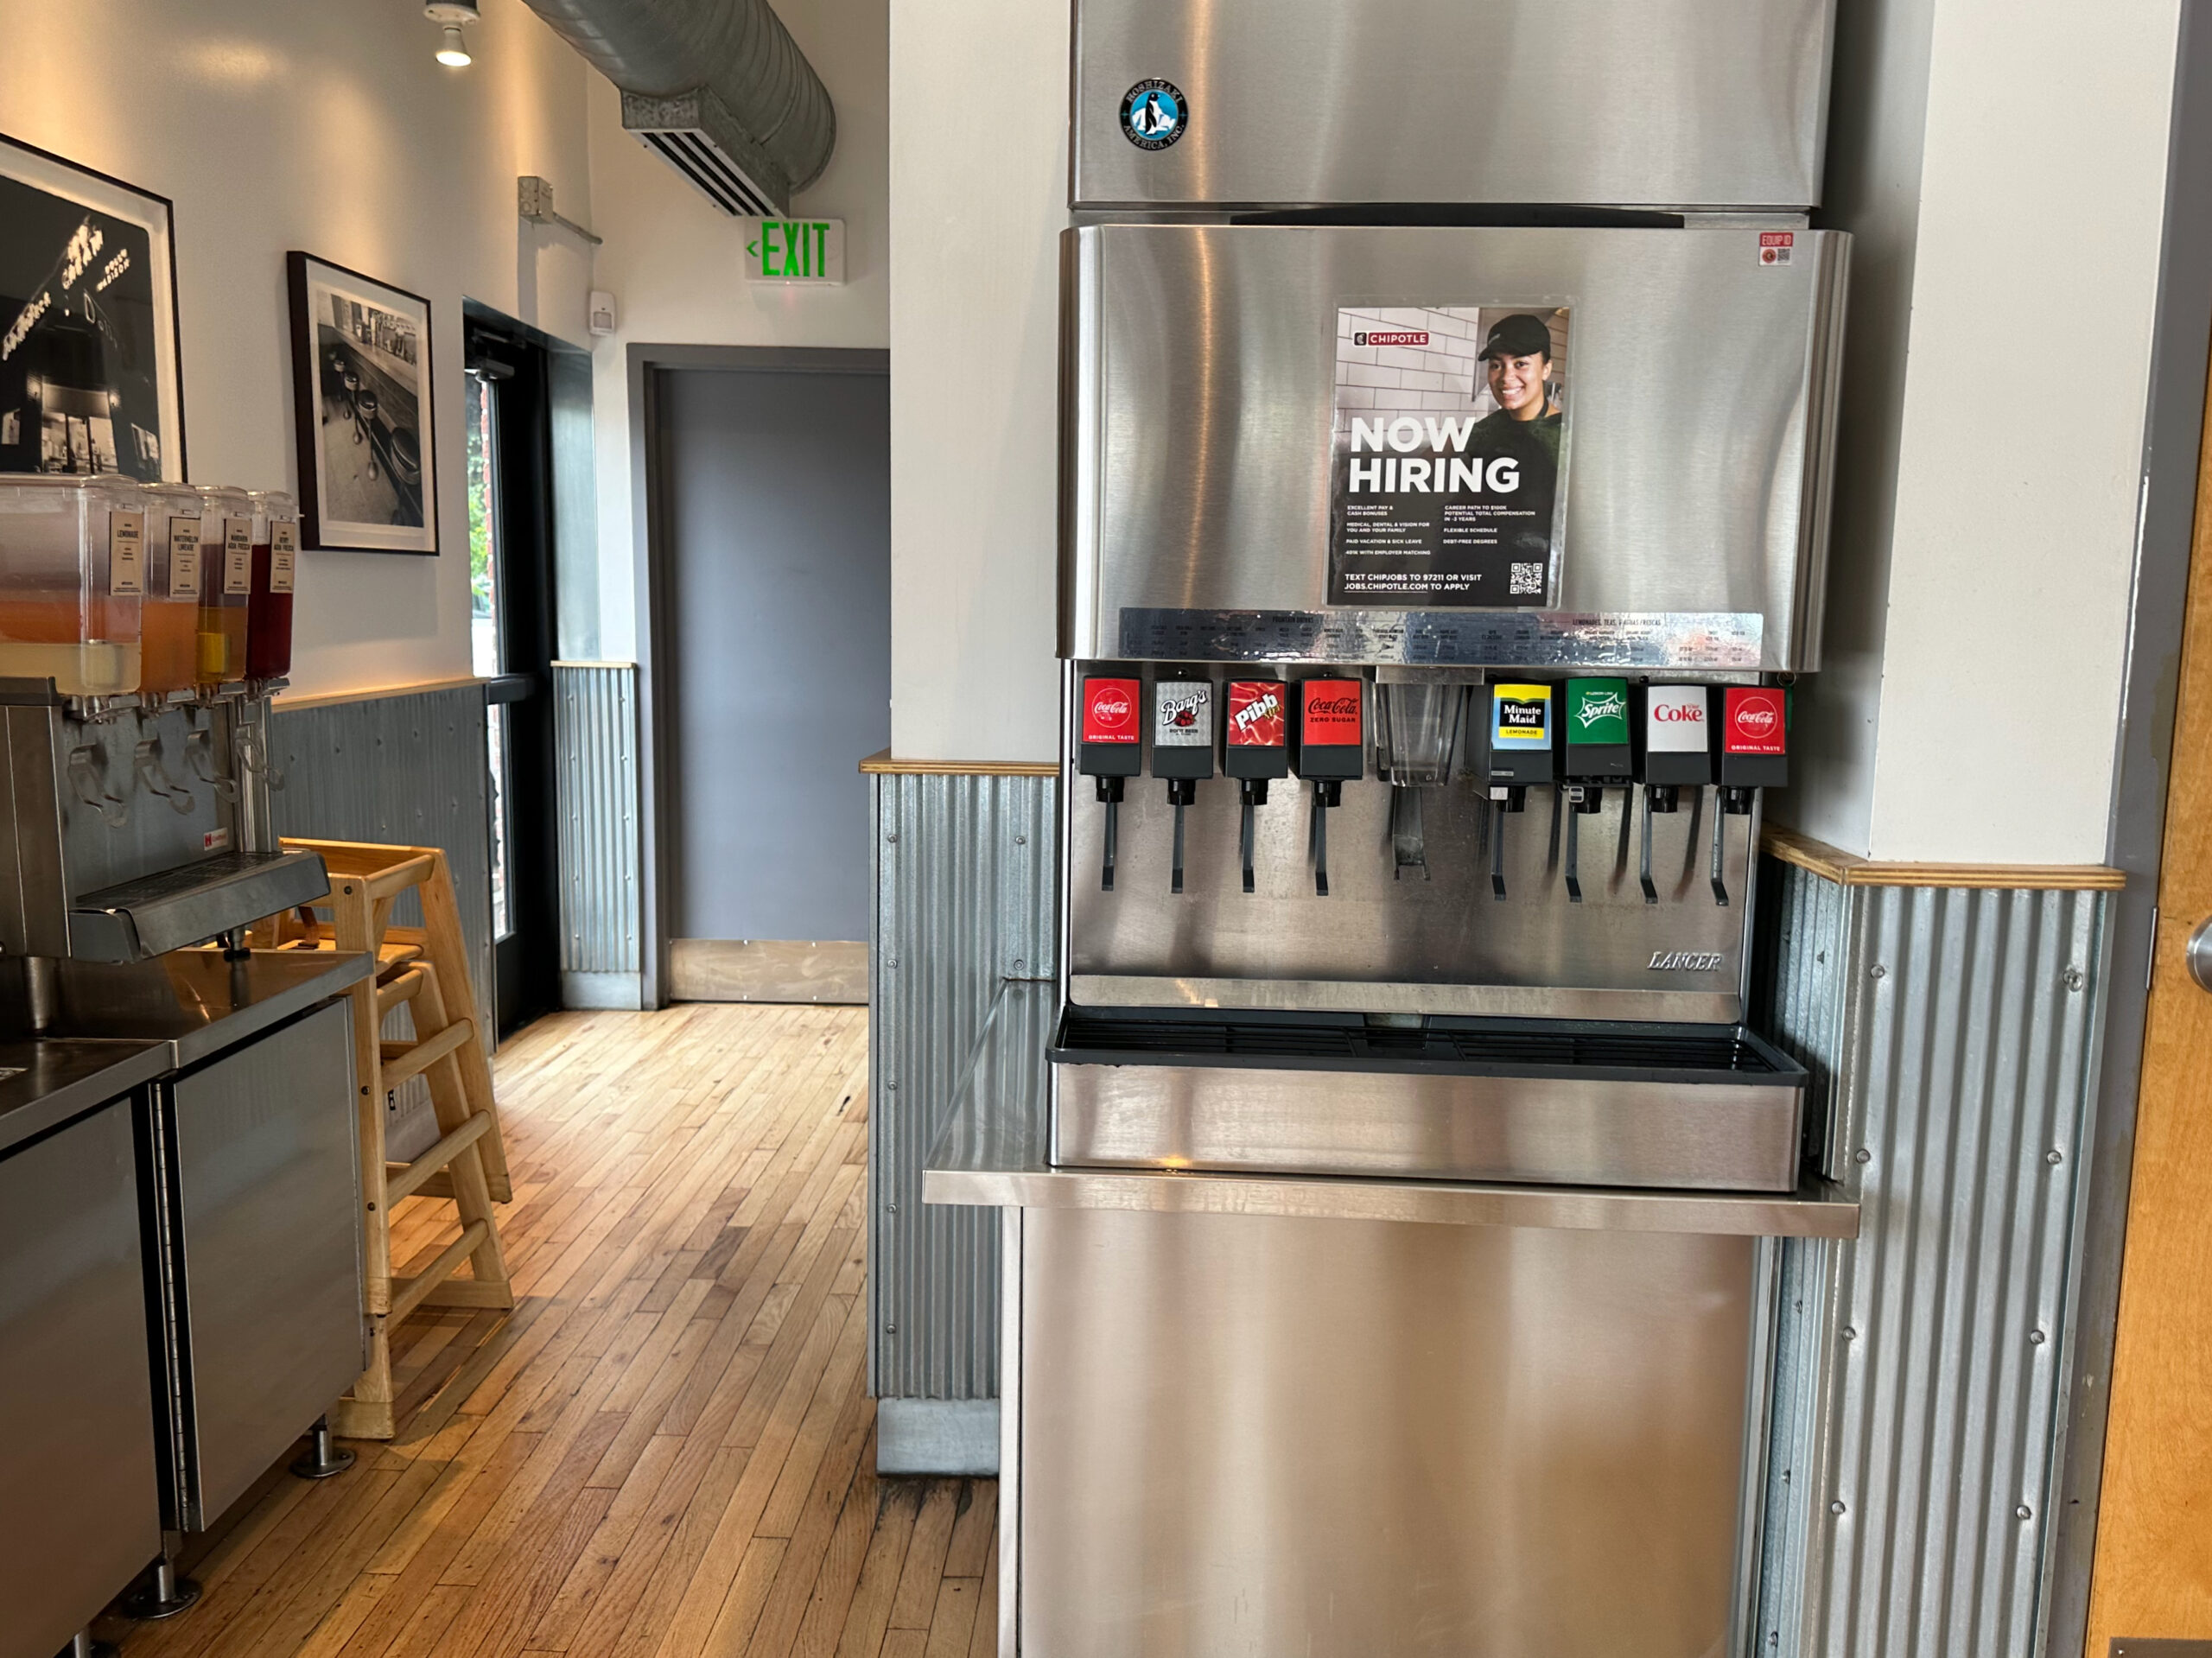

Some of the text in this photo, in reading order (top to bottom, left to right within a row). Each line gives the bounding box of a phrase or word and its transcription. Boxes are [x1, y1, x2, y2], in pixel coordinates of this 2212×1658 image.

[1126, 80, 1184, 104] HOSHIZAKI
[1123, 124, 1185, 149] AMERICA, INC.
[762, 221, 830, 277] EXIT
[1370, 334, 1427, 344] CHIPOTLE
[1350, 416, 1477, 453] NOW
[1348, 456, 1521, 493] HIRING
[1344, 573, 1366, 581] TEXT
[1367, 573, 1408, 581] CHIPJOBS
[1344, 582, 1428, 591] JOBS.CHIPOTLE.COM
[1094, 701, 1128, 715] Coca-Cola
[1160, 690, 1208, 726] Barq's
[1234, 693, 1279, 731] Pibb
[1308, 697, 1357, 715] Coca-Cola
[1503, 704, 1541, 715] Minute
[1580, 701, 1619, 719] Sprite
[1654, 704, 1702, 722] Coke
[1509, 715, 1536, 724] Maid
[1738, 710, 1774, 724] Coca-Cola
[1647, 951, 1722, 971] LANCER
